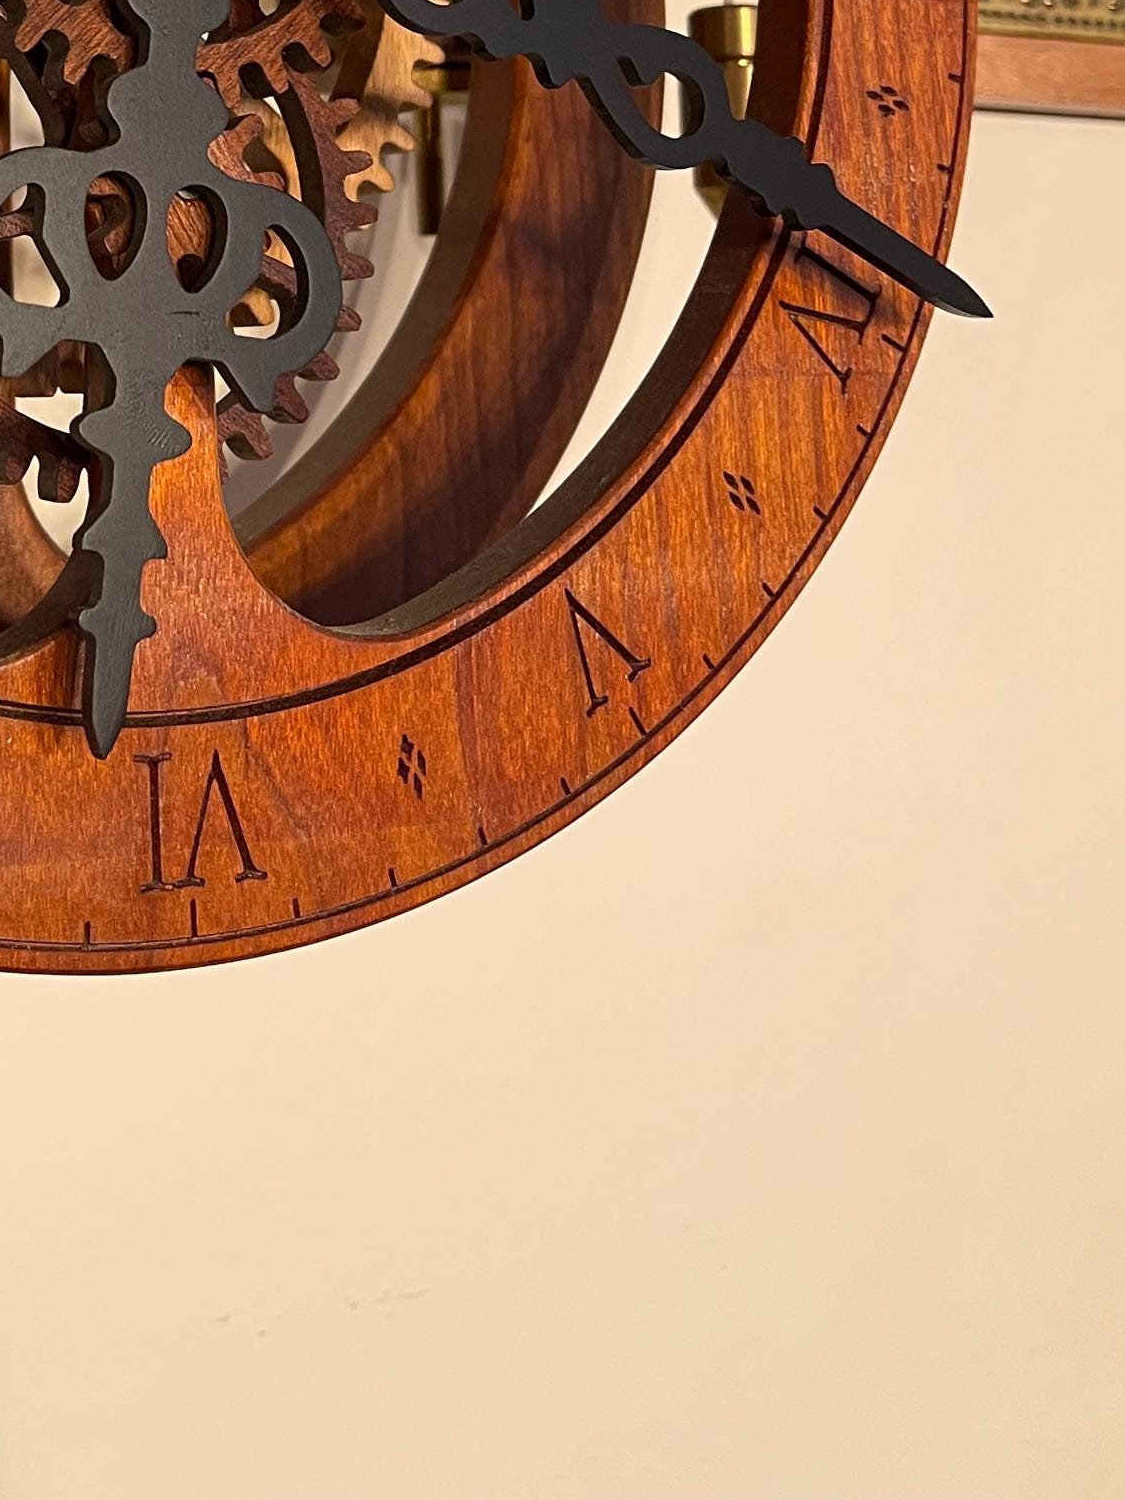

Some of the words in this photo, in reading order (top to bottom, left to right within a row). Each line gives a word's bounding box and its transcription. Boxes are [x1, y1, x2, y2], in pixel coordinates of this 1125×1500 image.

[778, 231, 882, 395] IV
[564, 587, 651, 718] V
[133, 749, 268, 893] VI
